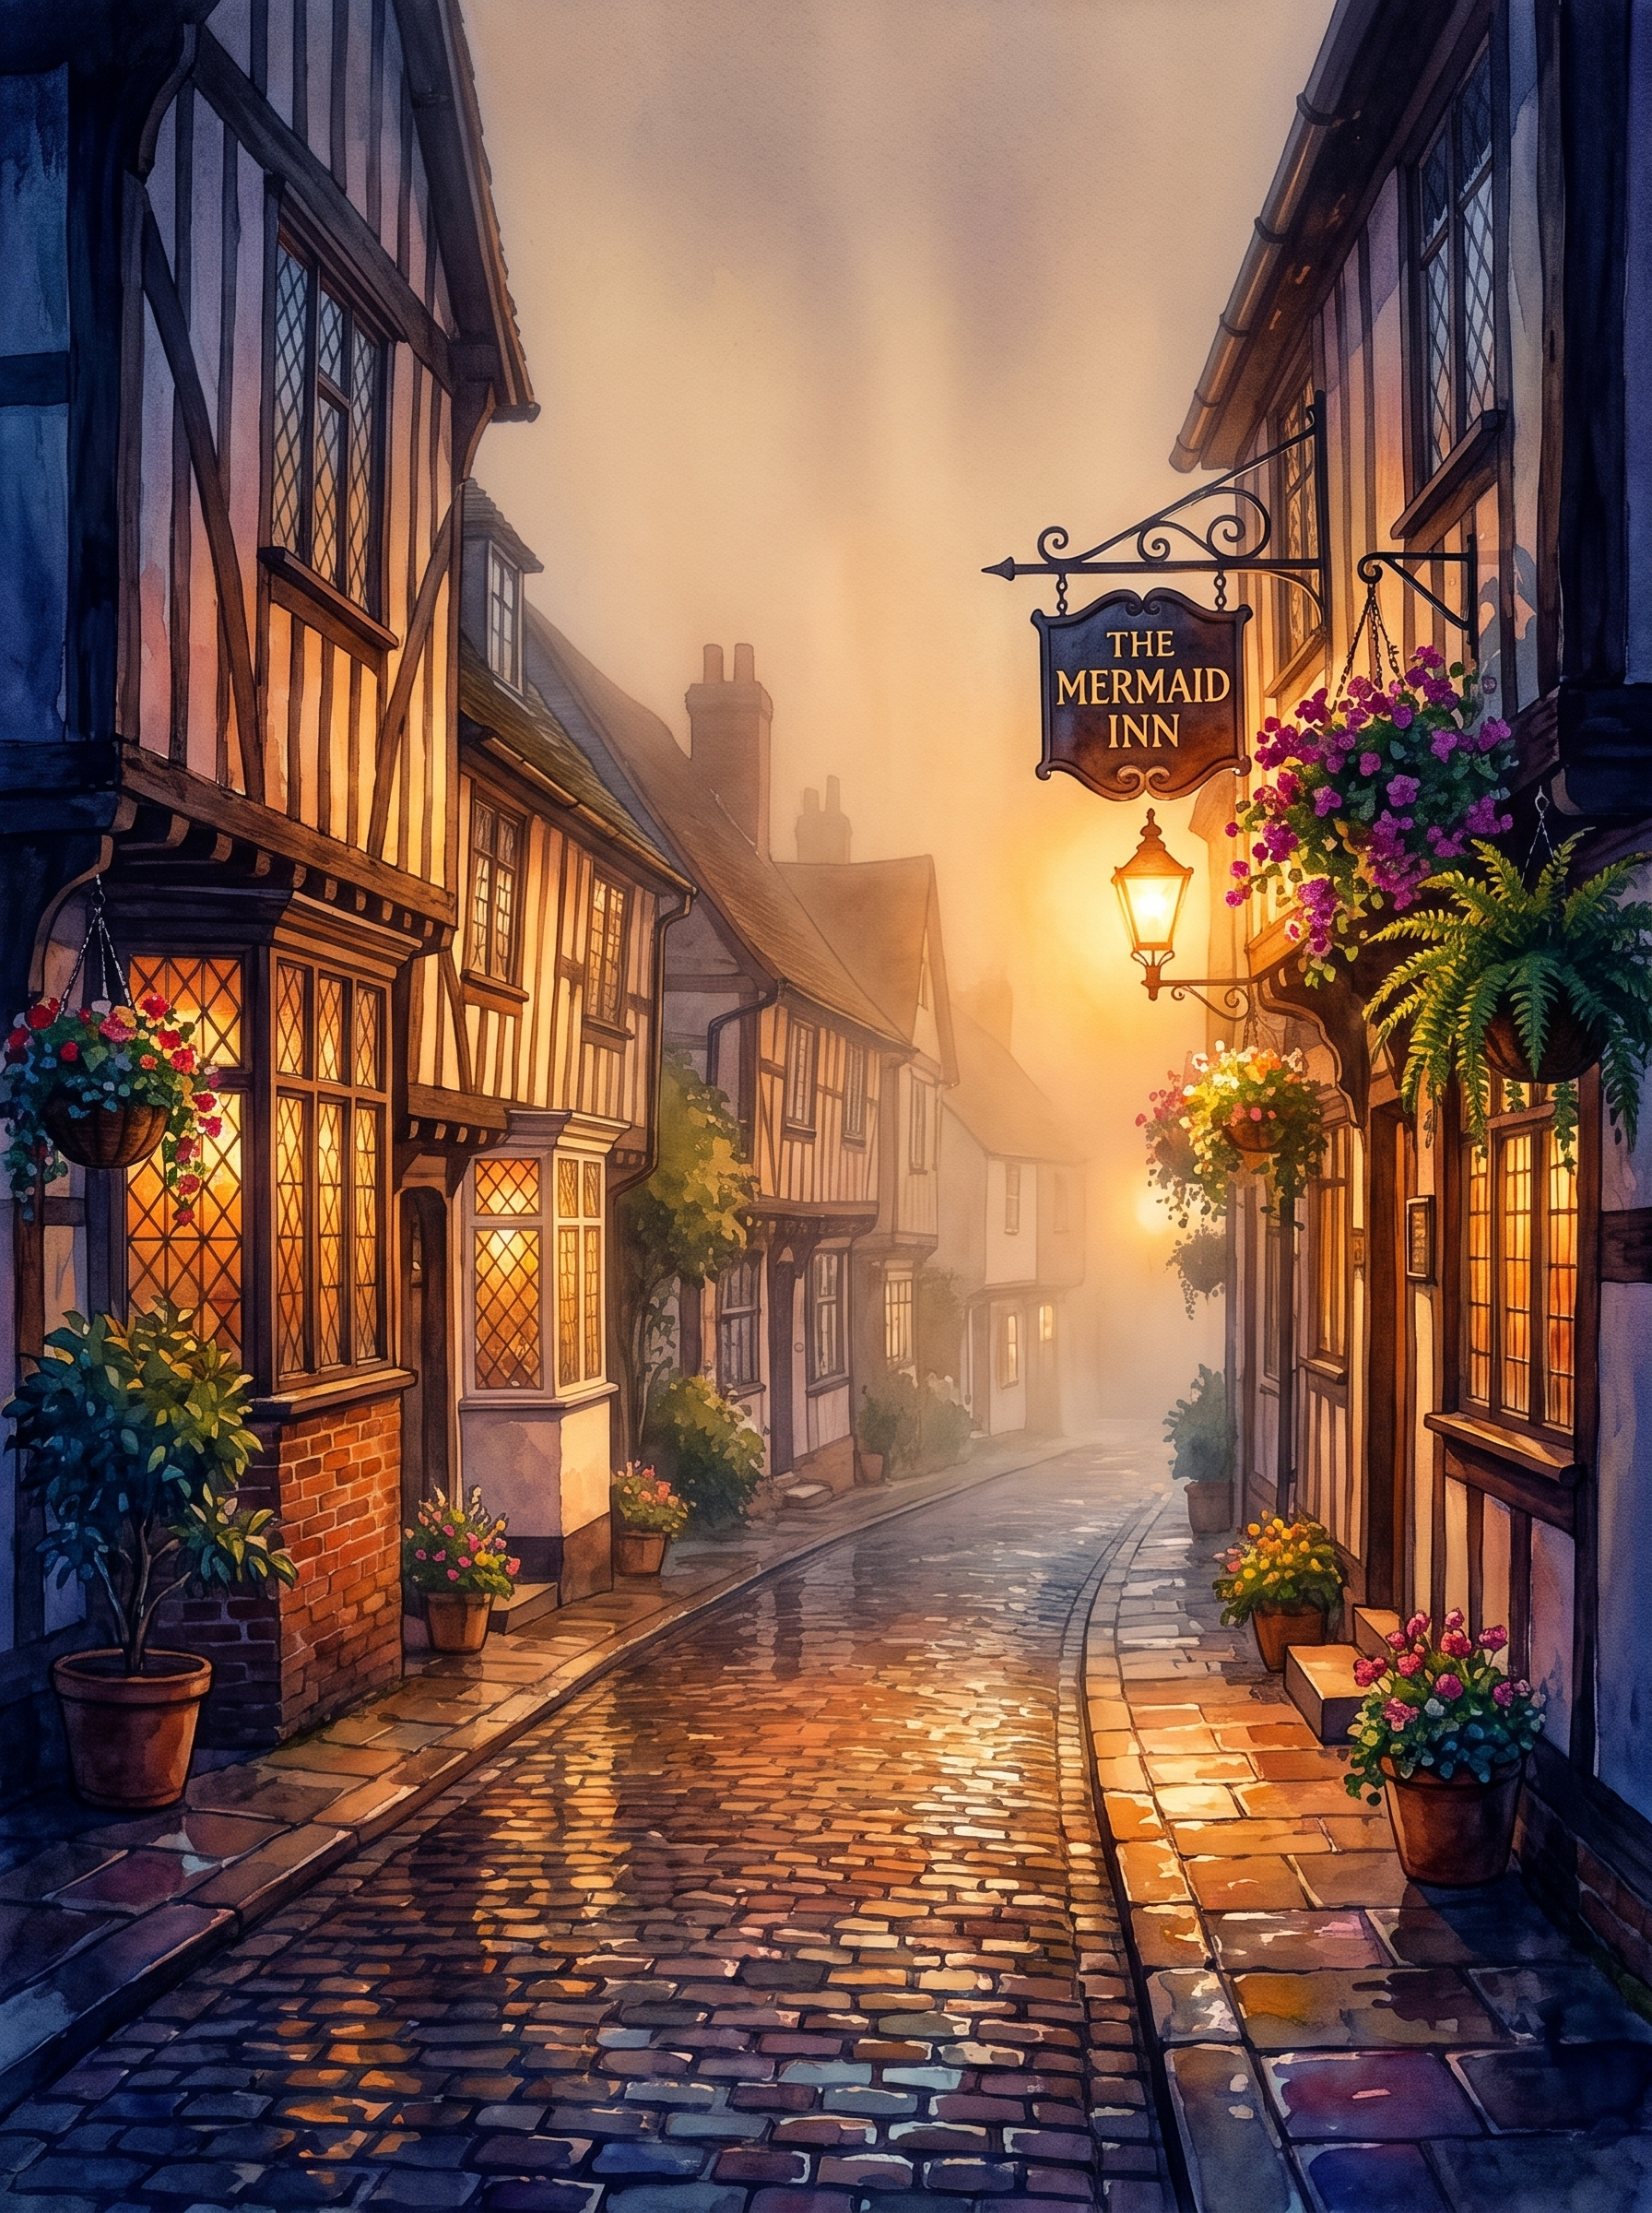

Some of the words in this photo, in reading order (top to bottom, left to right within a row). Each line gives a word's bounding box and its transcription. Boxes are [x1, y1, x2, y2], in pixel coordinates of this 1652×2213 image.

[1107, 631, 1174, 657] THE
[1056, 669, 1229, 704] MERMAID
[1109, 715, 1179, 748] INN
